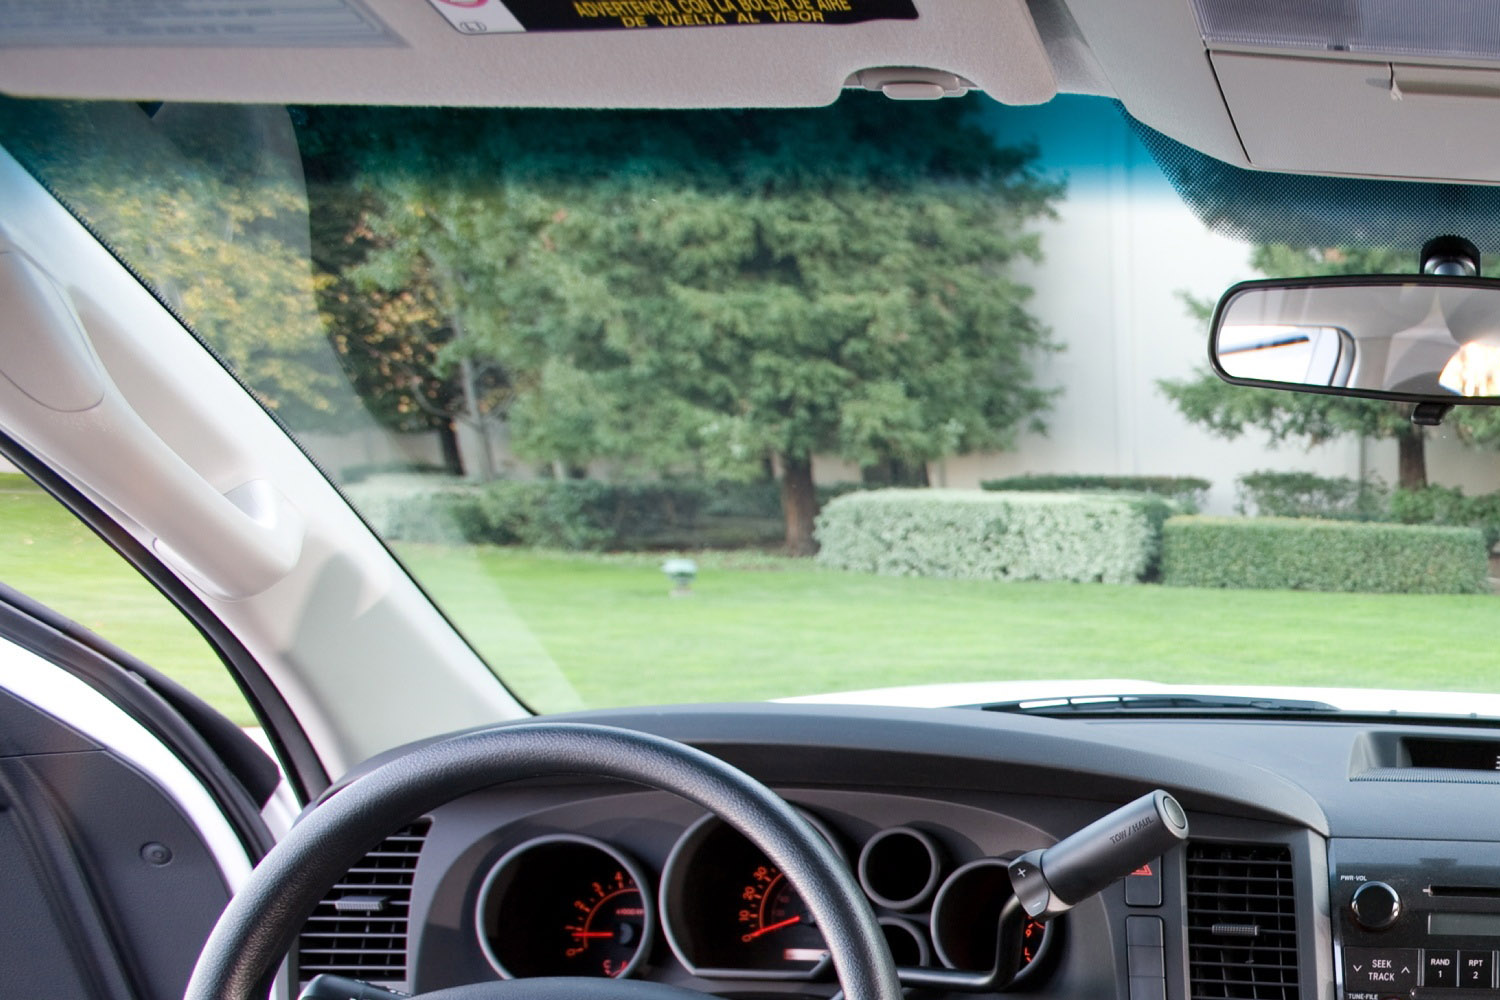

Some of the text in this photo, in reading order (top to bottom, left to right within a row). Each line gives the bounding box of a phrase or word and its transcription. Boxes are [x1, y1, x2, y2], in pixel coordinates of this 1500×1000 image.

[679, 0, 714, 13] CON
[621, 11, 825, 28] DE VUELTA AL VISOR
[1372, 960, 1392, 968] SEEK
[1430, 958, 1450, 966] RAND
[1368, 972, 1395, 981] TRACK
[1438, 970, 1442, 978] 1
[1473, 971, 1478, 979] 2
